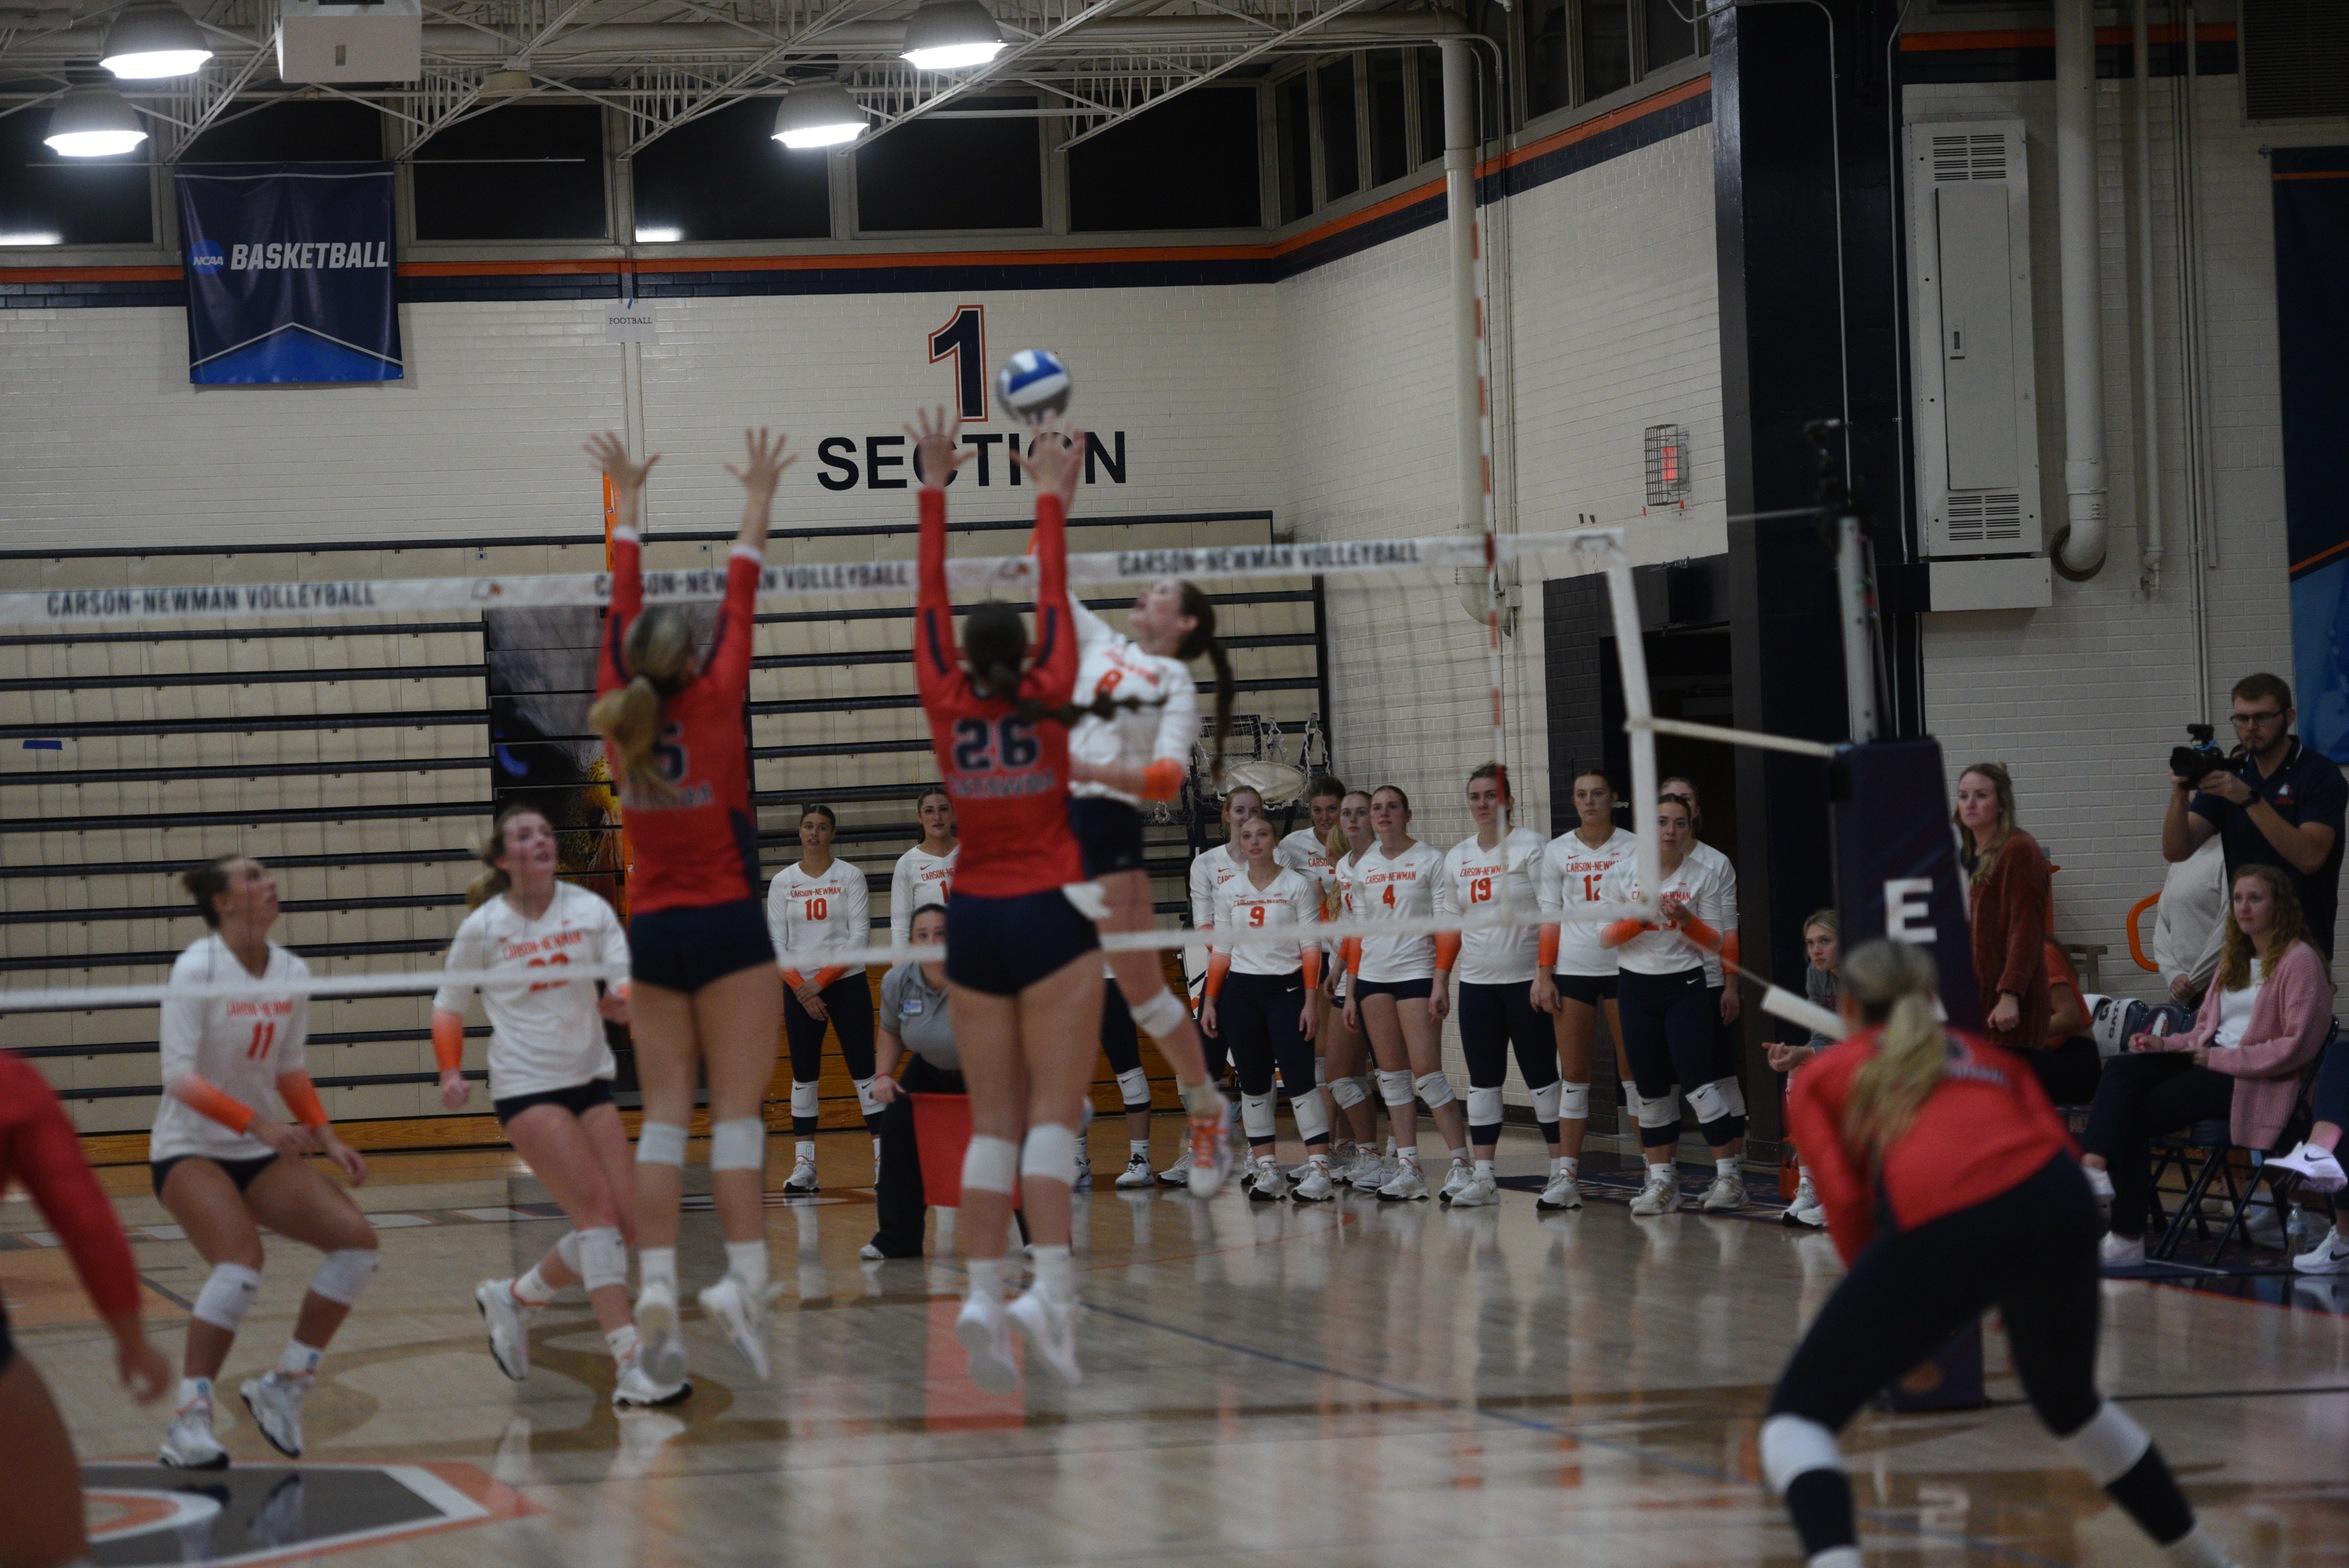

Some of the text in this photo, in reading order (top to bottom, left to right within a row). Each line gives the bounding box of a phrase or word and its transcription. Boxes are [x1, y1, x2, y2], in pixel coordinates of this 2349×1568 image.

[192, 241, 389, 270] NCAA BASKETBALL
[609, 316, 653, 325] FOOTBALL
[928, 304, 988, 422] 1
[1118, 541, 1420, 576] CARSON-NEWMAN VOLLEYBALL
[785, 564, 908, 590] VOLLEYBALL
[47, 582, 374, 617] CARSON-NEWMAN VOLLEYBALL
[951, 713, 1043, 773] 26
[1365, 870, 1417, 885] CARSON-NEWMAN
[1471, 877, 1491, 904] 19
[790, 886, 842, 898] CARSON-NEWMAN
[1382, 884, 1396, 910] 4
[805, 898, 827, 921] 10
[1249, 906, 1265, 928] 9
[1883, 877, 1938, 943] E
[247, 1021, 275, 1060] 11
